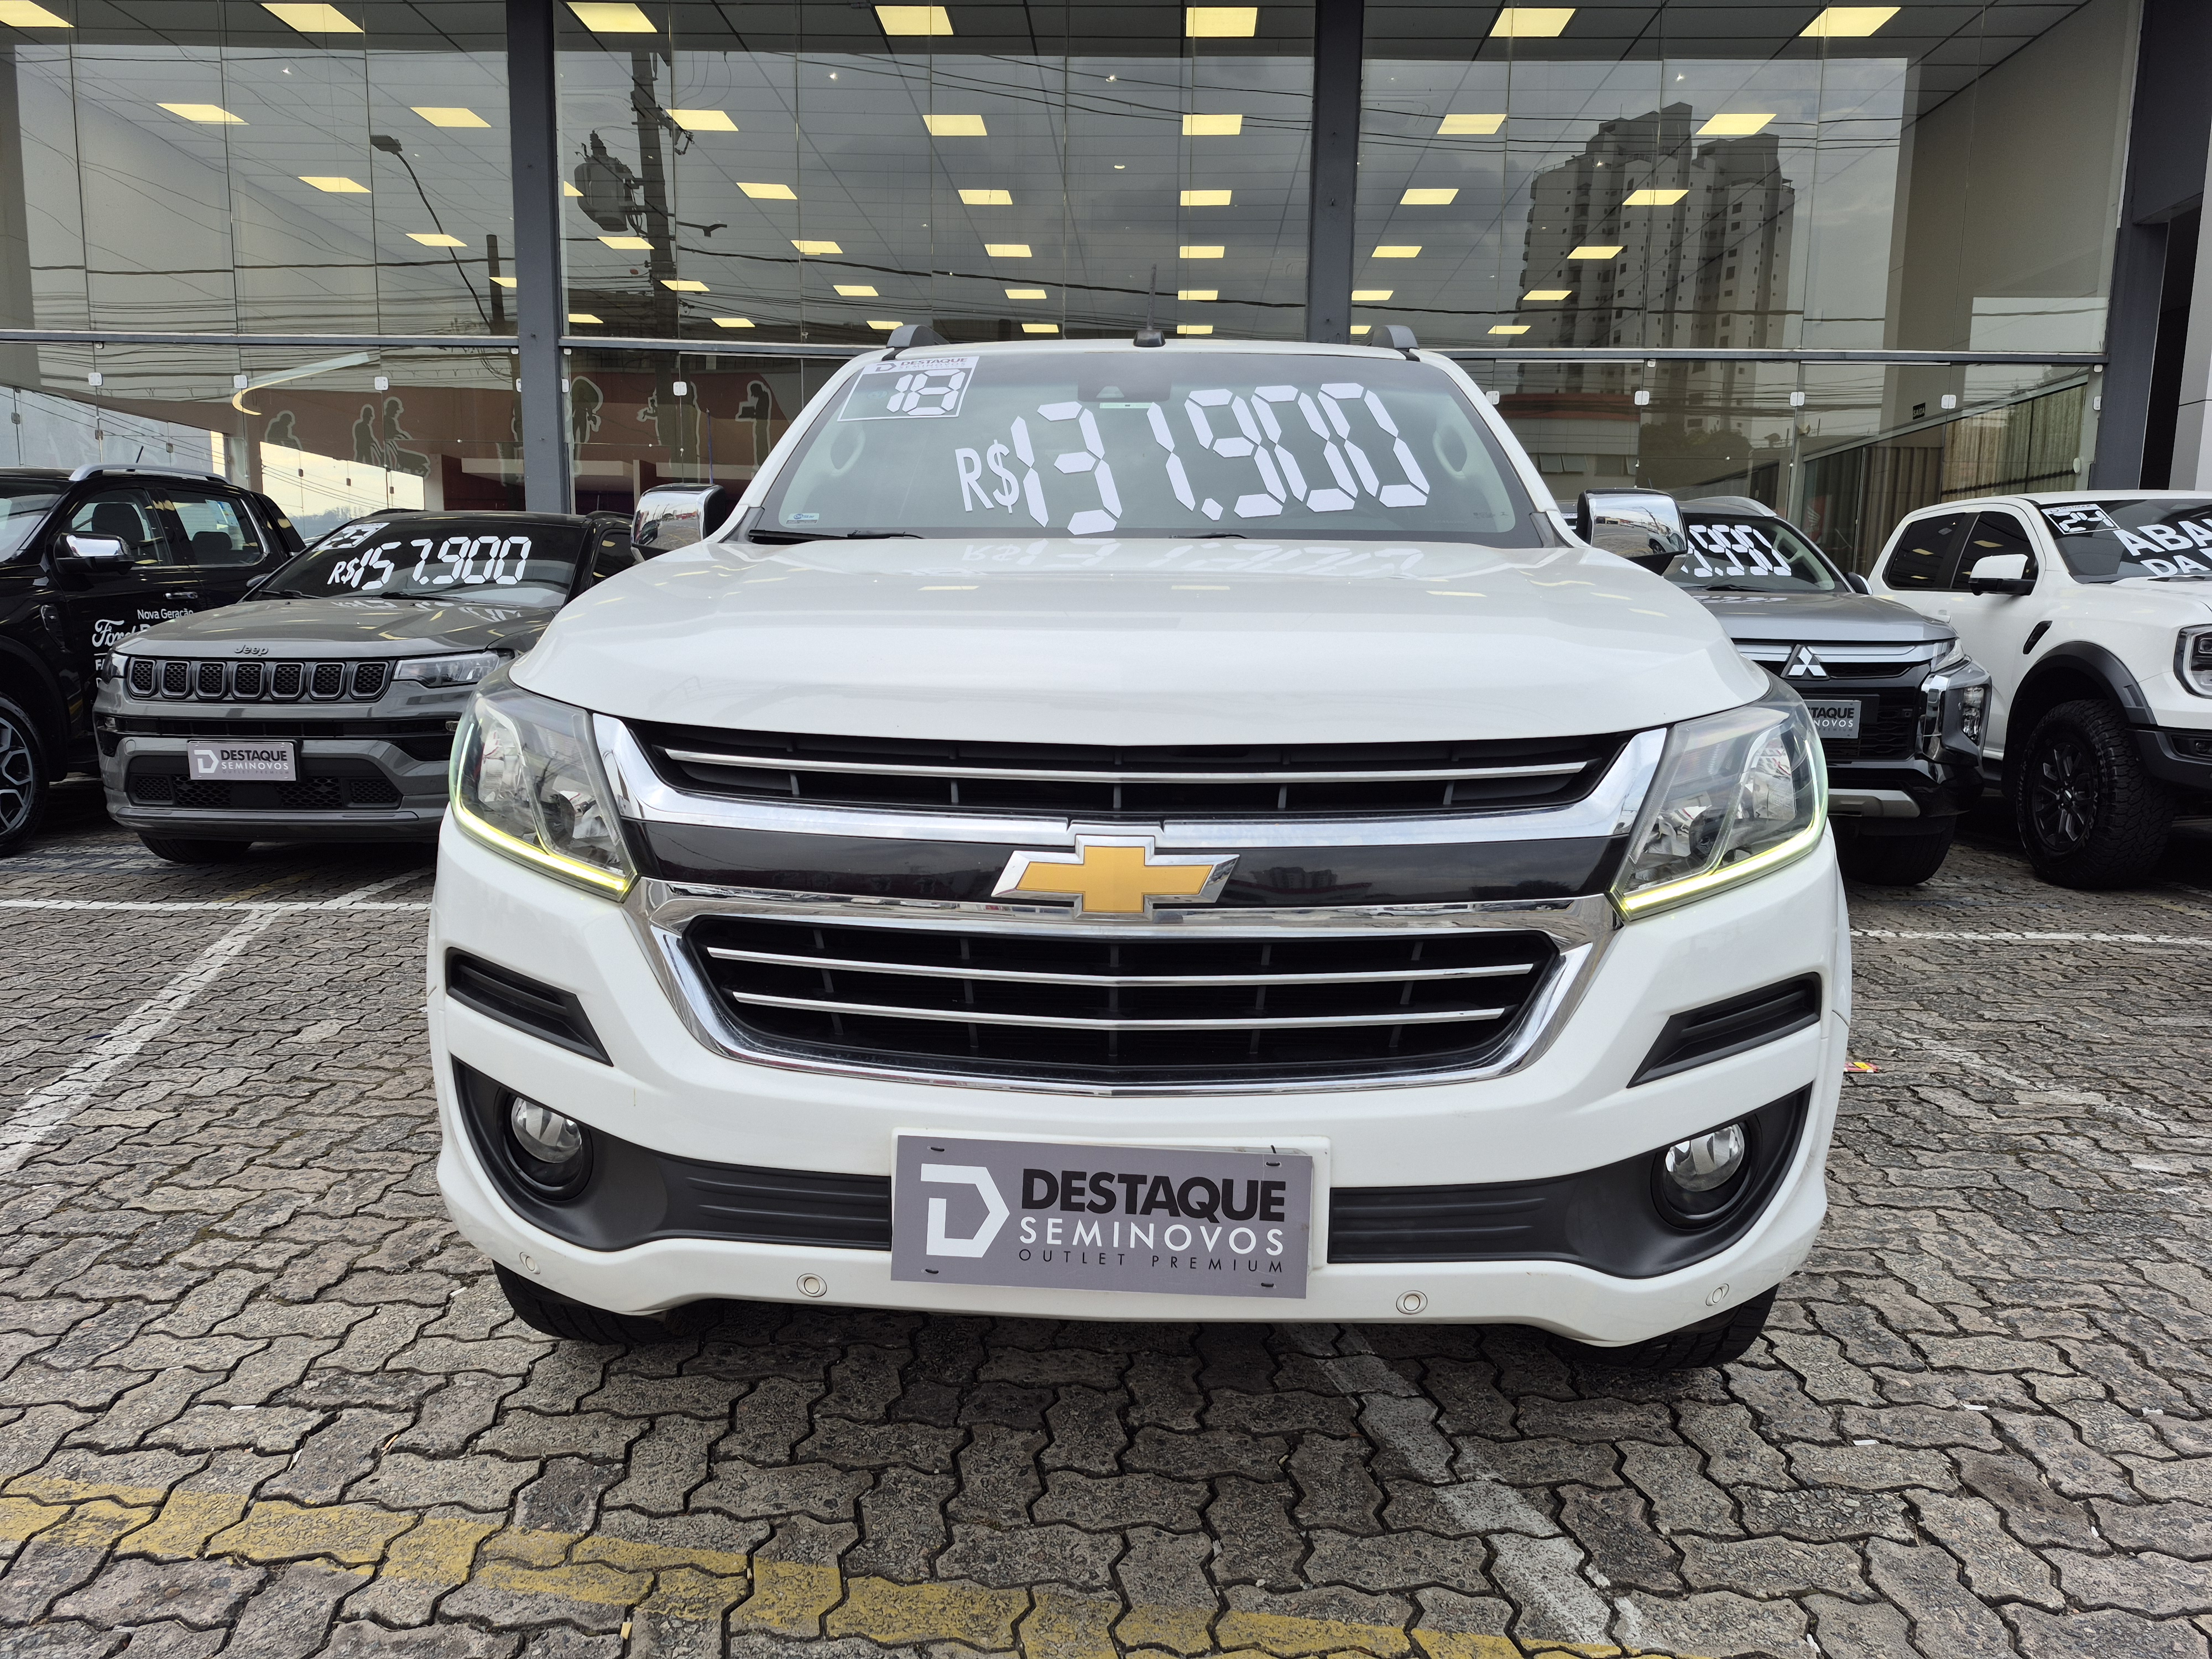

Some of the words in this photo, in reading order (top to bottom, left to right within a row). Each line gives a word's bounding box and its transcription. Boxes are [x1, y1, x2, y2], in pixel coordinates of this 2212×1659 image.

[886, 369, 966, 415] 18
[2053, 510, 2114, 532] 24
[318, 528, 377, 549] 23
[2112, 519, 2212, 556] ABA
[2140, 555, 2211, 577] DA
[137, 609, 159, 620] Nova
[234, 644, 269, 656] Jeep
[1808, 707, 1854, 719] TAQUE
[221, 750, 288, 762] DESTAQUE
[222, 762, 289, 770] SEMINOVOS
[1021, 1168, 1286, 1224] DESTAQUE
[1019, 1216, 1284, 1256] SEMINOVOS
[1019, 1248, 1125, 1266] OUTLET
[1151, 1255, 1283, 1273] PREMIUM
